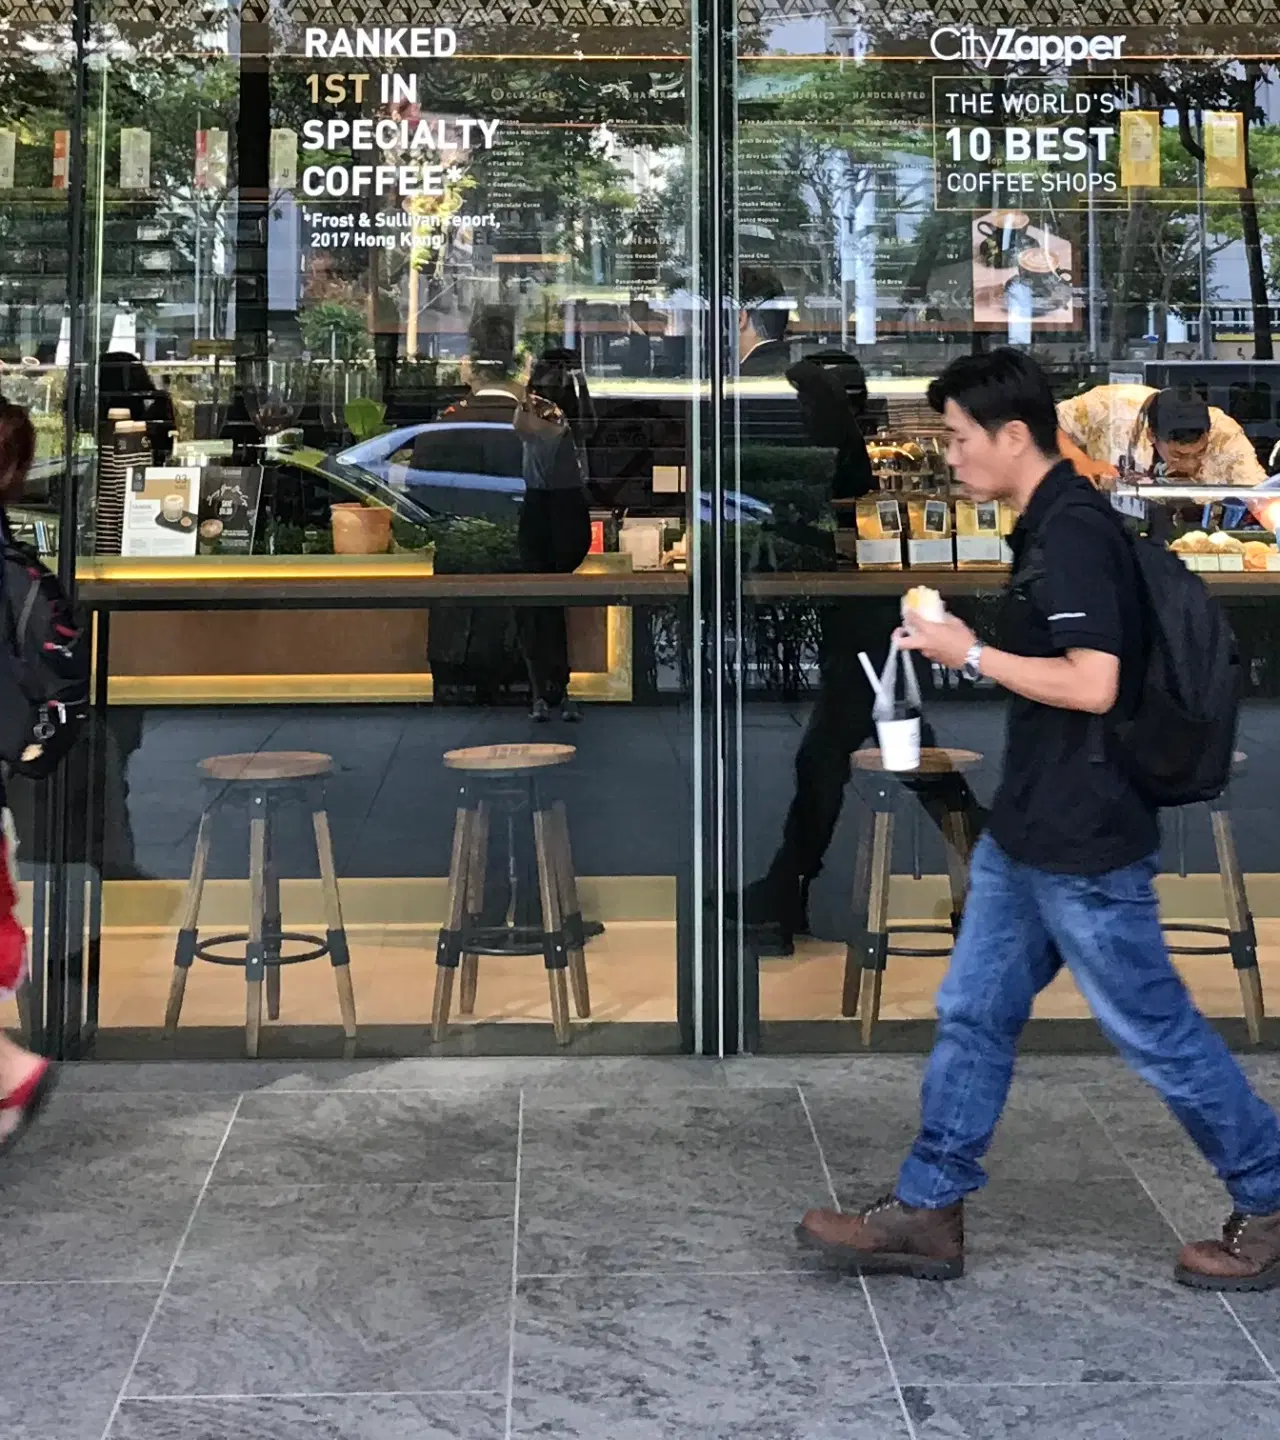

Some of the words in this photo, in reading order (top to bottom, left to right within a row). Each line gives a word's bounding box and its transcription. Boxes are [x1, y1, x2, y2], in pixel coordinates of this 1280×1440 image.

[304, 28, 457, 58] RANKED
[930, 27, 1126, 68] CityZapper
[306, 74, 370, 104] 1ST
[380, 73, 417, 104] IN
[945, 93, 994, 114] THE
[1002, 93, 1114, 114] WORLD'S
[302, 118, 500, 150] SPECIALTY
[946, 127, 991, 161] 10
[1005, 127, 1114, 161] BEST
[947, 173, 1034, 192] COFFEE
[1042, 173, 1116, 192] SHOPS
[358, 213, 371, 228] &
[375, 212, 440, 228] Sullivan
[311, 232, 350, 248] 2017
[354, 232, 395, 250] Hong
